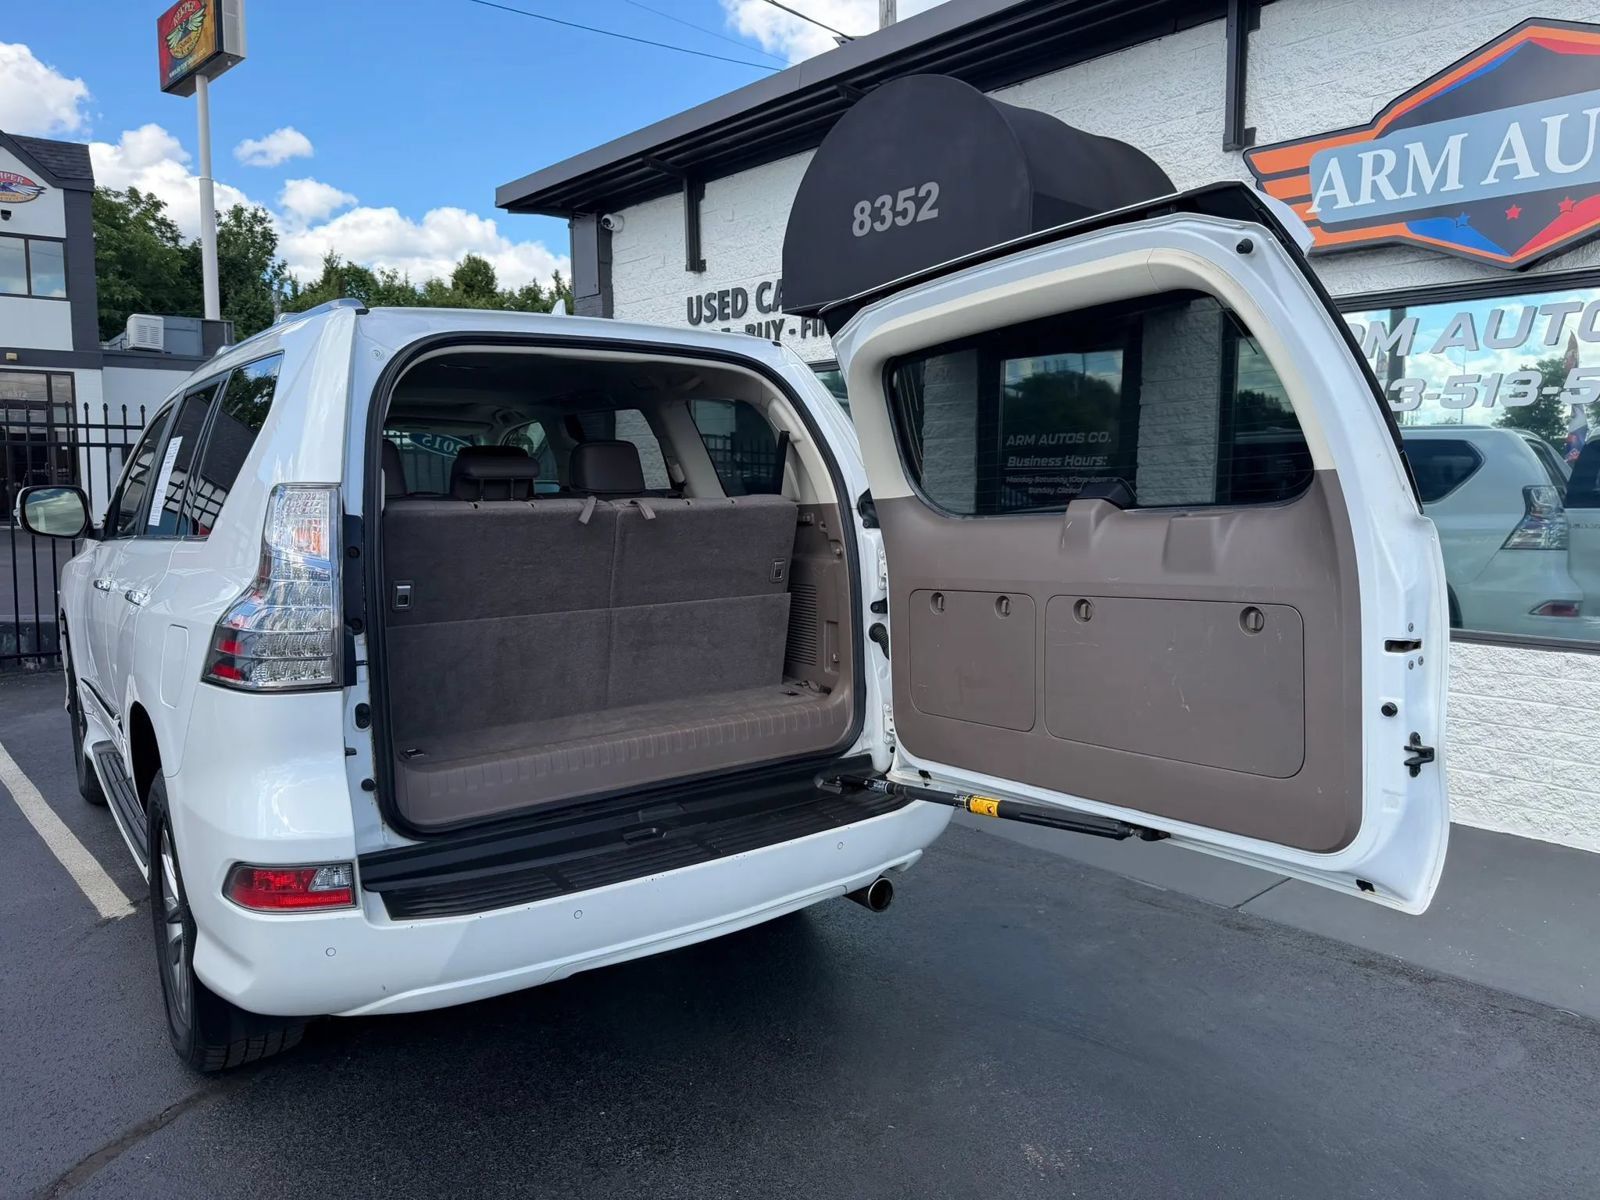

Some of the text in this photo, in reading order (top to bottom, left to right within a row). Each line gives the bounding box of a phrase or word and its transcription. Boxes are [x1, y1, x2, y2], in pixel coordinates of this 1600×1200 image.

[1306, 107, 1600, 213] ARM AU
[852, 181, 940, 237] 8352
[686, 287, 748, 325] USED
[1006, 434, 1036, 446] ARM
[1038, 431, 1085, 446] AUTOS
[1007, 455, 1063, 467] Business
